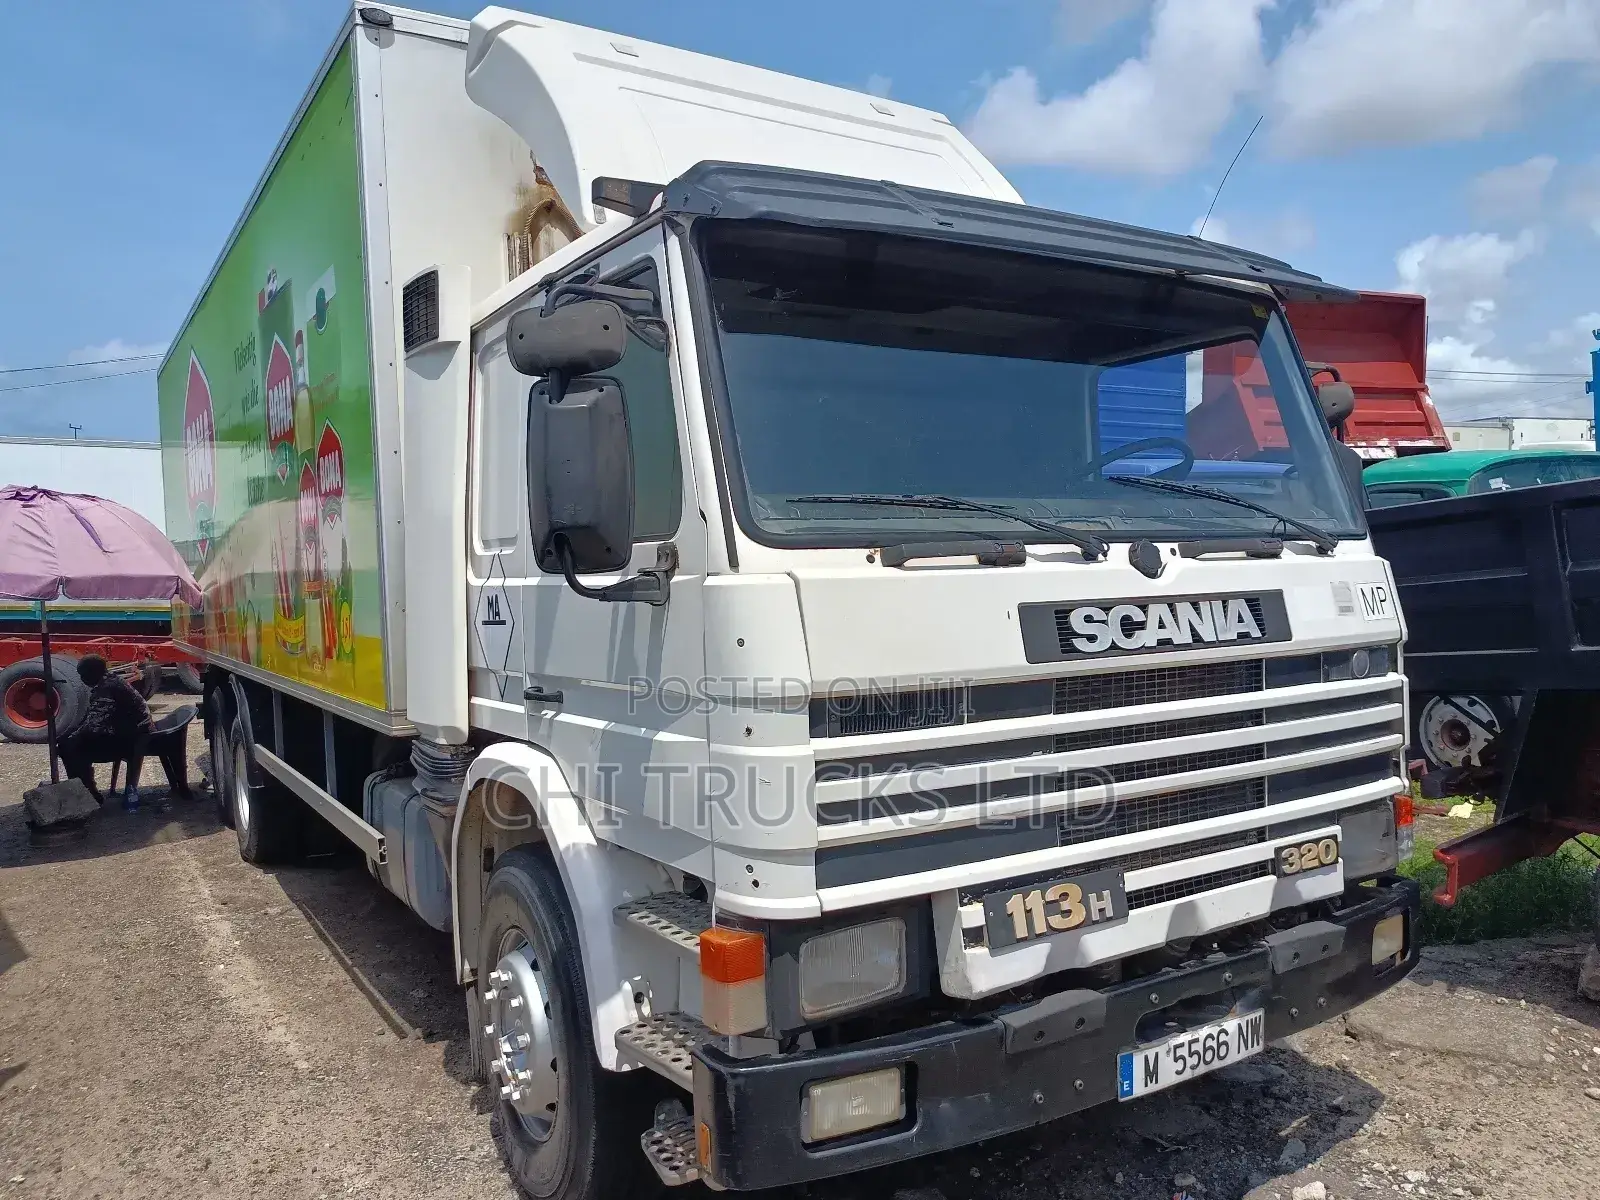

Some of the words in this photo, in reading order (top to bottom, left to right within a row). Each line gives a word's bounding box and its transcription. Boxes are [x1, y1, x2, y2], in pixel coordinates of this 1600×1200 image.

[268, 375, 294, 440] BONA
[319, 449, 342, 494] BONA
[487, 594, 501, 620] MA
[1360, 586, 1387, 616] MP
[1069, 599, 1263, 653] SCANIA
[1281, 838, 1339, 874] 320
[1005, 883, 1087, 940] 113
[1089, 889, 1114, 922] H
[1144, 1052, 1159, 1088] M
[1173, 1027, 1230, 1076] 5566
[1237, 1014, 1263, 1055] NW
[1123, 1081, 1131, 1091] E
